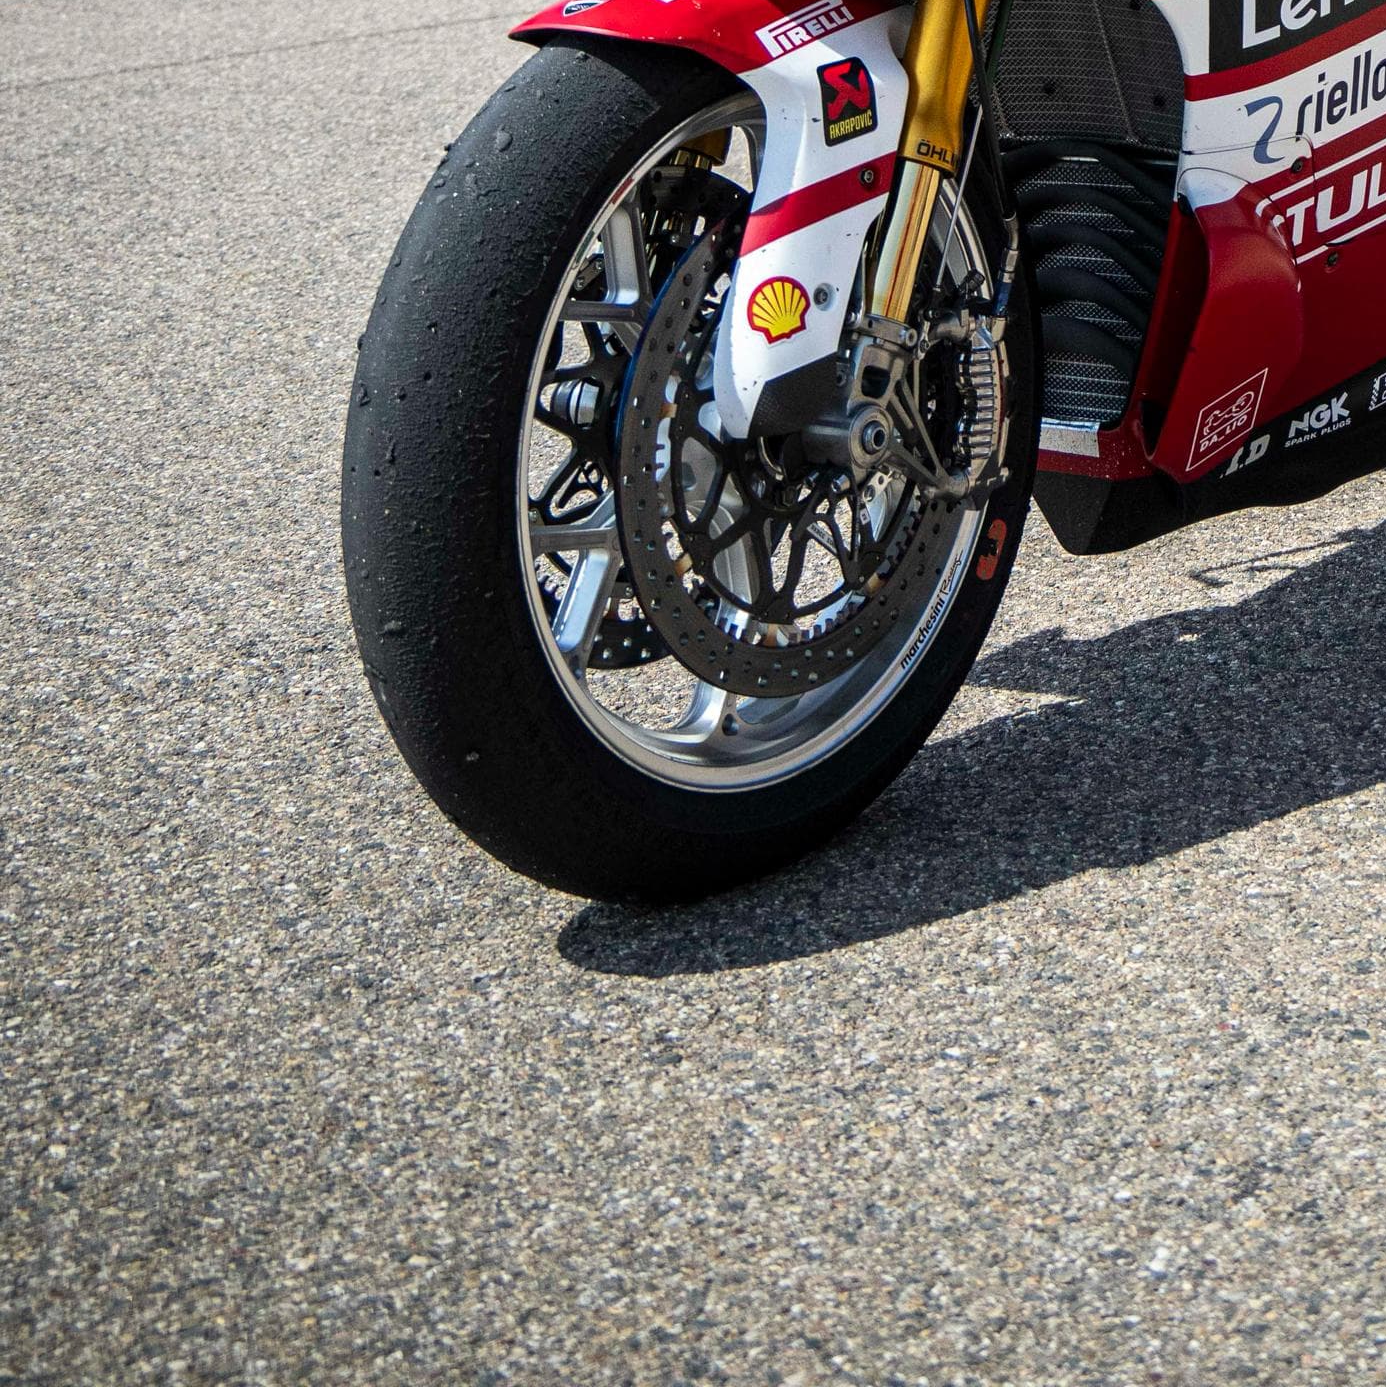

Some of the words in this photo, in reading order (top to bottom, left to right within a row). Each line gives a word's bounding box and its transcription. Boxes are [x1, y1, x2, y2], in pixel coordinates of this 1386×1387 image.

[1284, 432, 1318, 449] SPARK
[1320, 417, 1352, 435] PLUGS
[1288, 391, 1350, 439] NGK
[901, 599, 945, 669] marchesini
